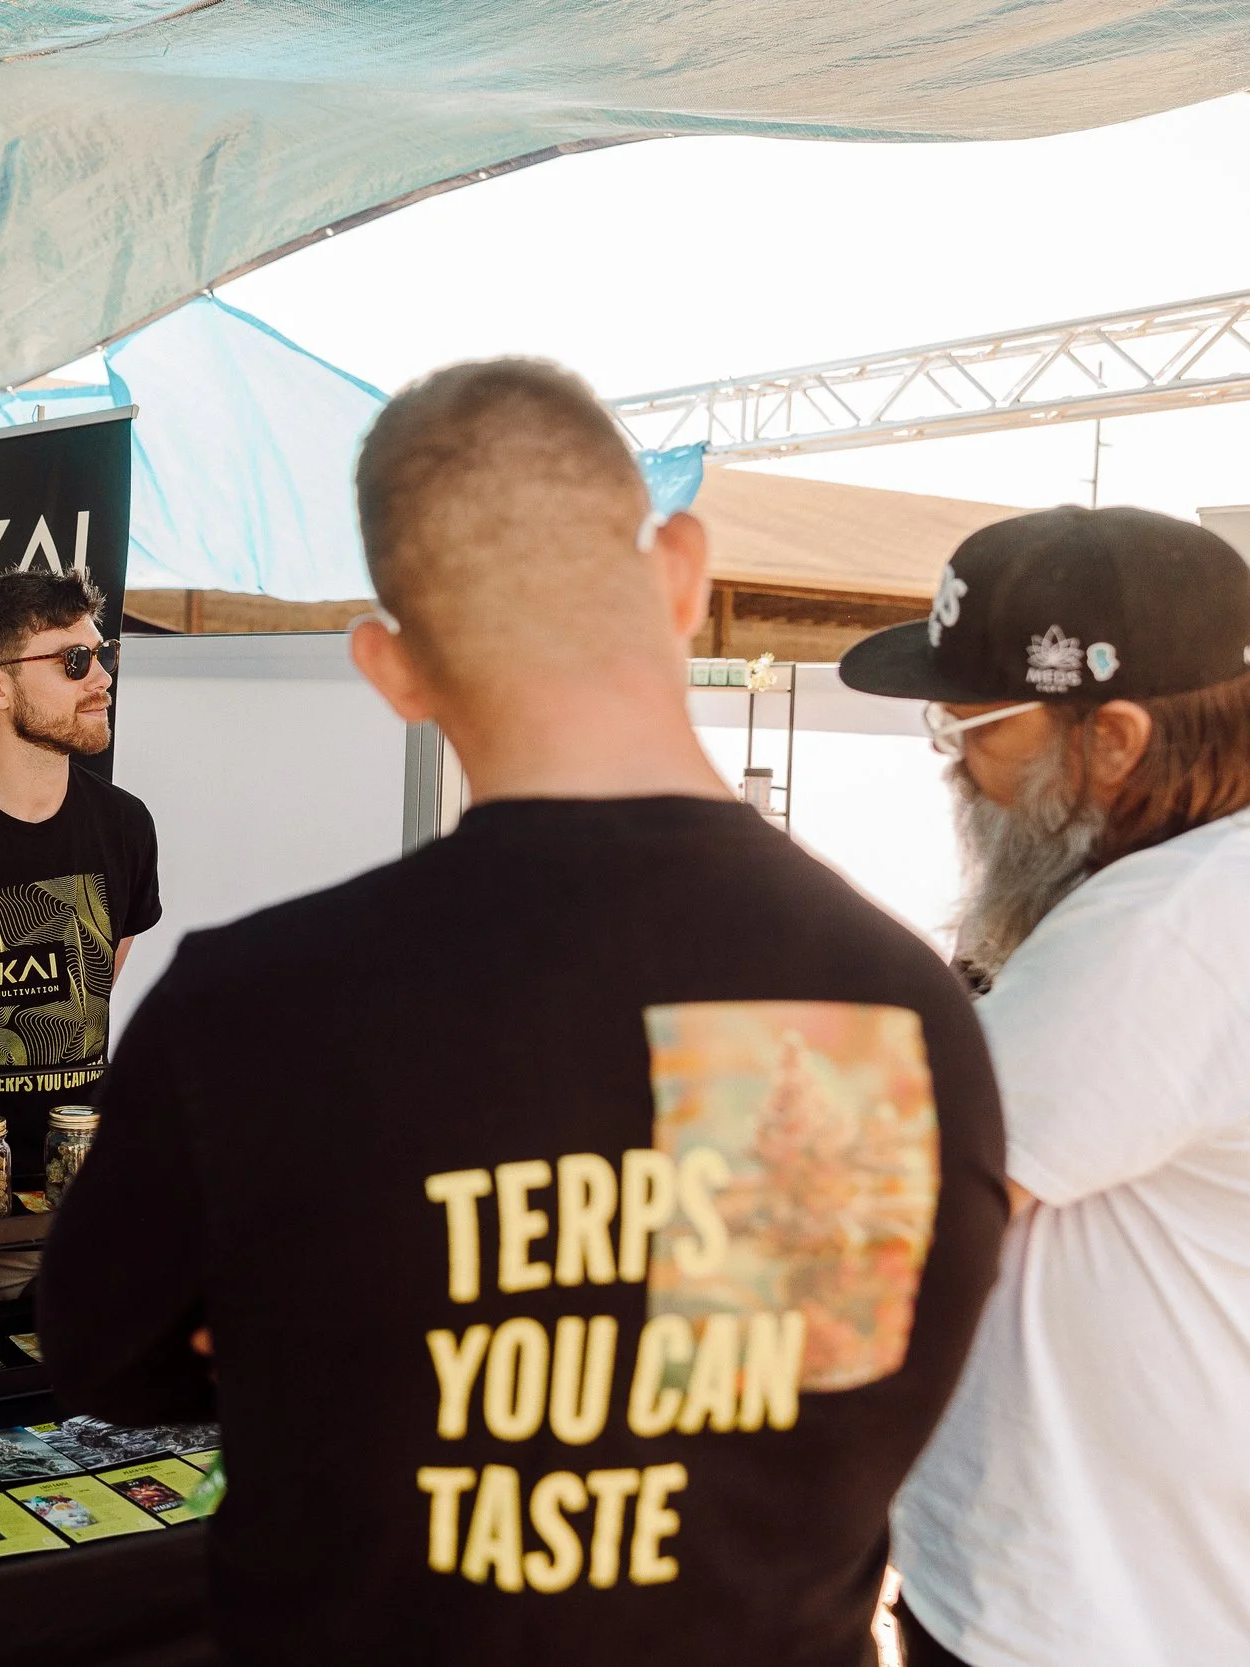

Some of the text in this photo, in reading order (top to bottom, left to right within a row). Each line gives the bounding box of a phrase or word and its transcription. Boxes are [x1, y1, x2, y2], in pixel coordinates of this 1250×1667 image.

[1025, 667, 1082, 686] MEDS
[36, 1074, 62, 1092] YOU
[63, 1071, 85, 1089] CAN
[425, 1146, 731, 1303] TERPS
[425, 1311, 806, 1446] YOU CAN
[416, 1462, 689, 1594] TASTE
